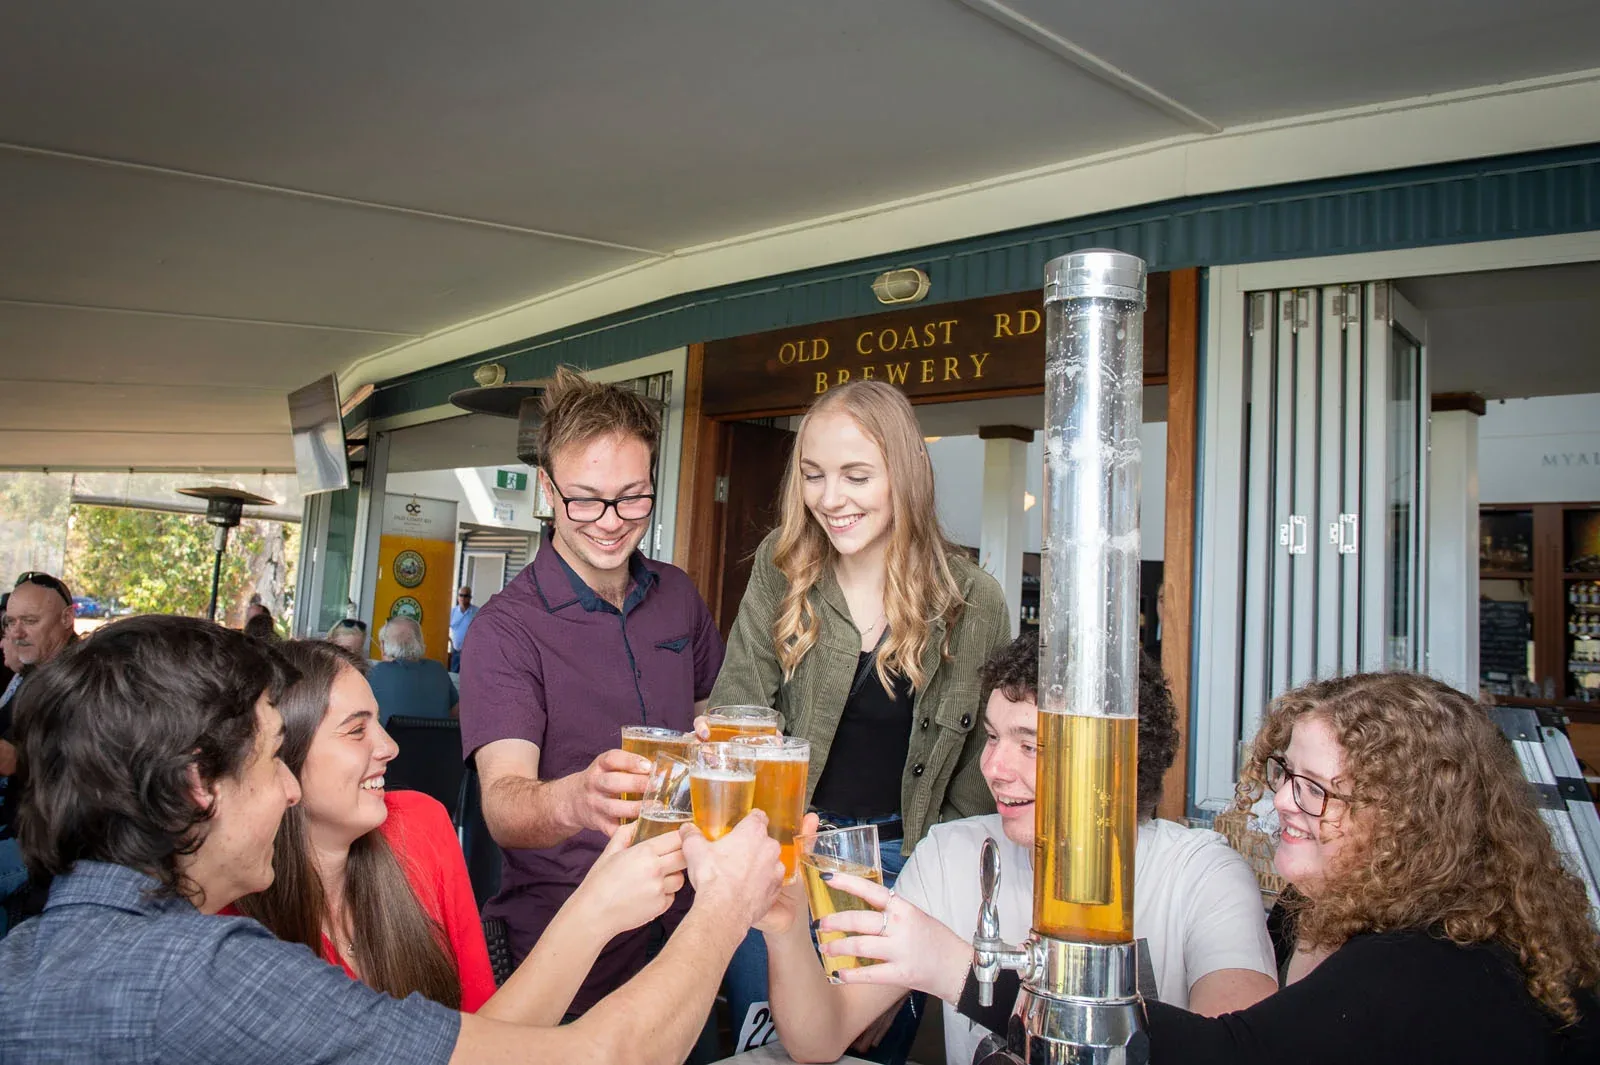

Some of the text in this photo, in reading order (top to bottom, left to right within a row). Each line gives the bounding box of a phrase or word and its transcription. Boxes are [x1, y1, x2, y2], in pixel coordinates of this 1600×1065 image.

[779, 309, 1041, 364] OLD COAST RD
